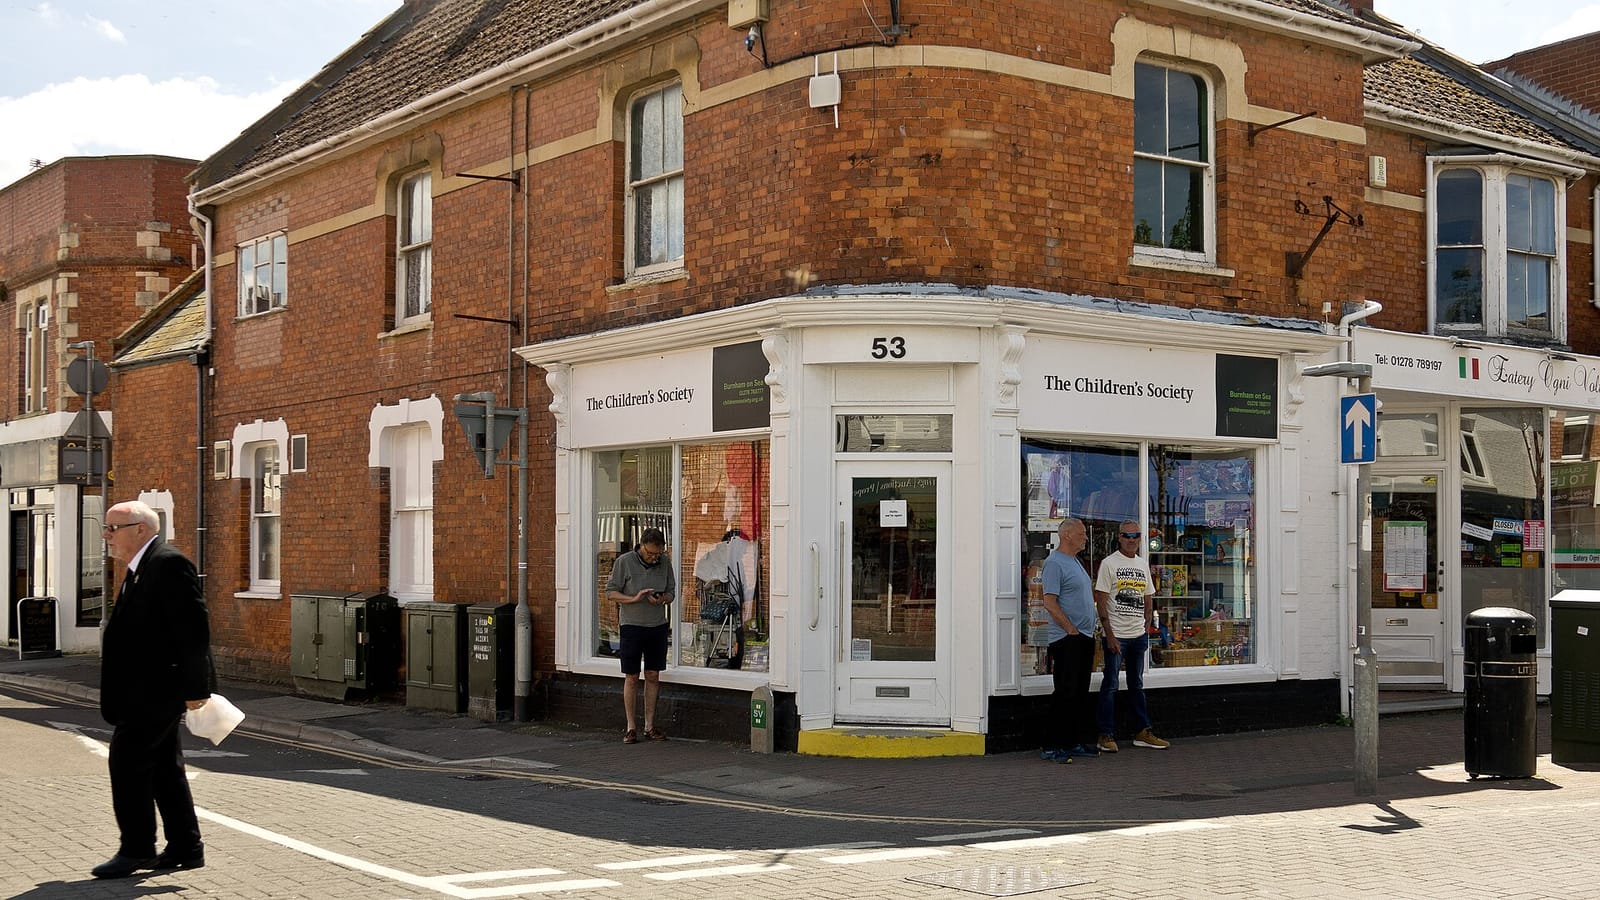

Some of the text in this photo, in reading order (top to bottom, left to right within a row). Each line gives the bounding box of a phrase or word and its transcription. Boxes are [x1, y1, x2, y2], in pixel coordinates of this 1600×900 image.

[871, 336, 907, 360] 53
[1375, 353, 1442, 371] Tel: 01278 789197
[1487, 354, 1535, 393] Eatery
[586, 386, 695, 411] The Children's Society
[1044, 375, 1194, 404] The Children's Society
[1494, 520, 1514, 530] CLOSED
[753, 709, 764, 718] SV
